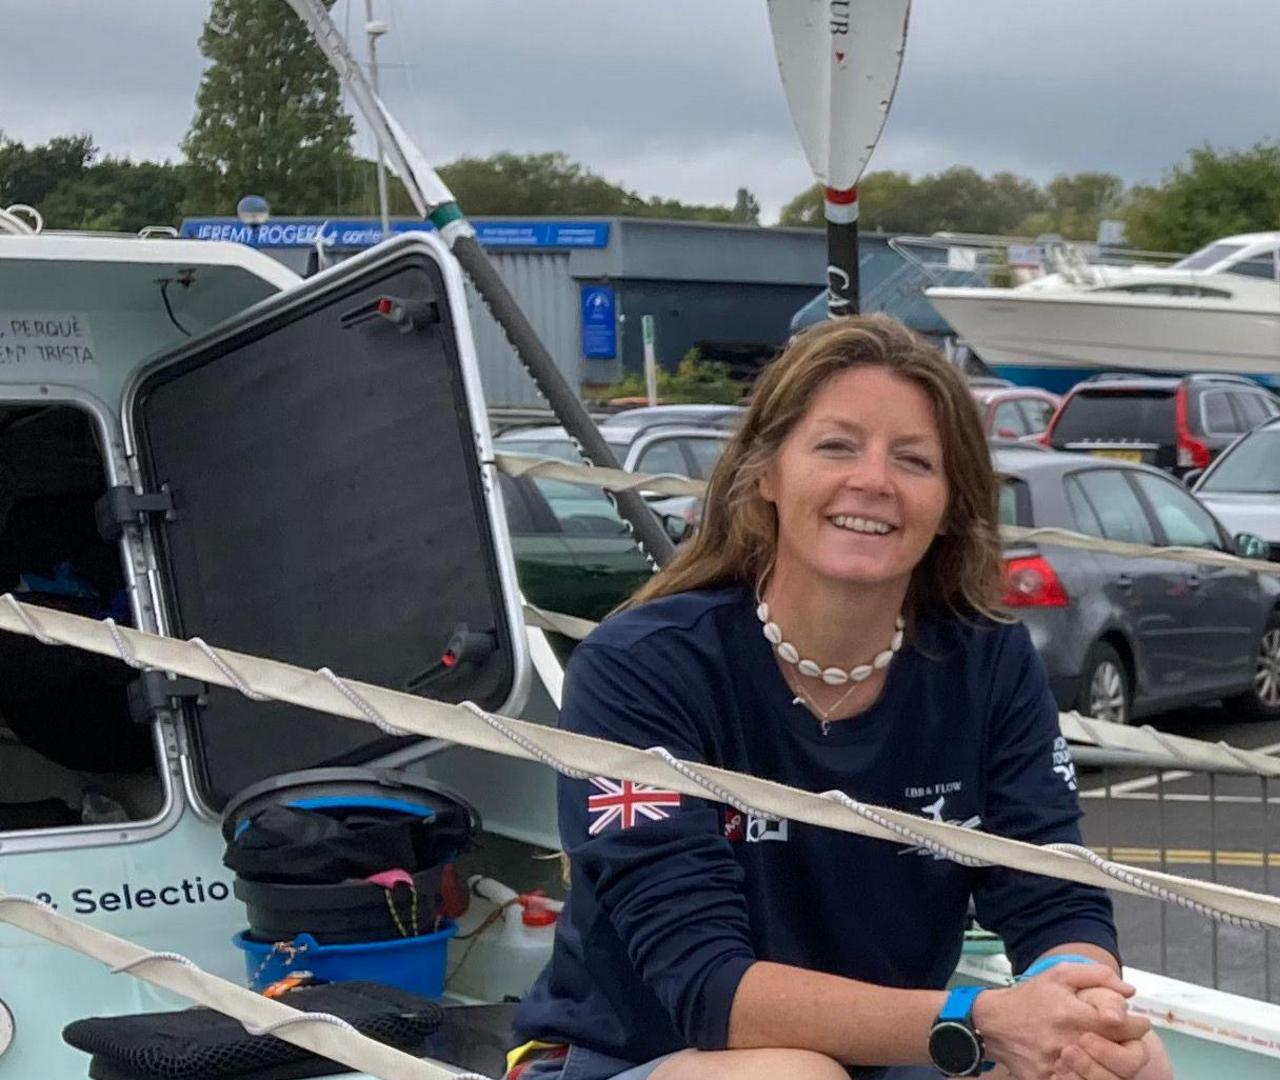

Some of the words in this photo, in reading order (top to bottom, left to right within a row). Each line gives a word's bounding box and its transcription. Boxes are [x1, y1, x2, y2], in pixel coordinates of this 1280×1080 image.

[198, 225, 254, 243] JEREMY
[935, 781, 962, 794] FLOW
[72, 876, 236, 914] Selectio
